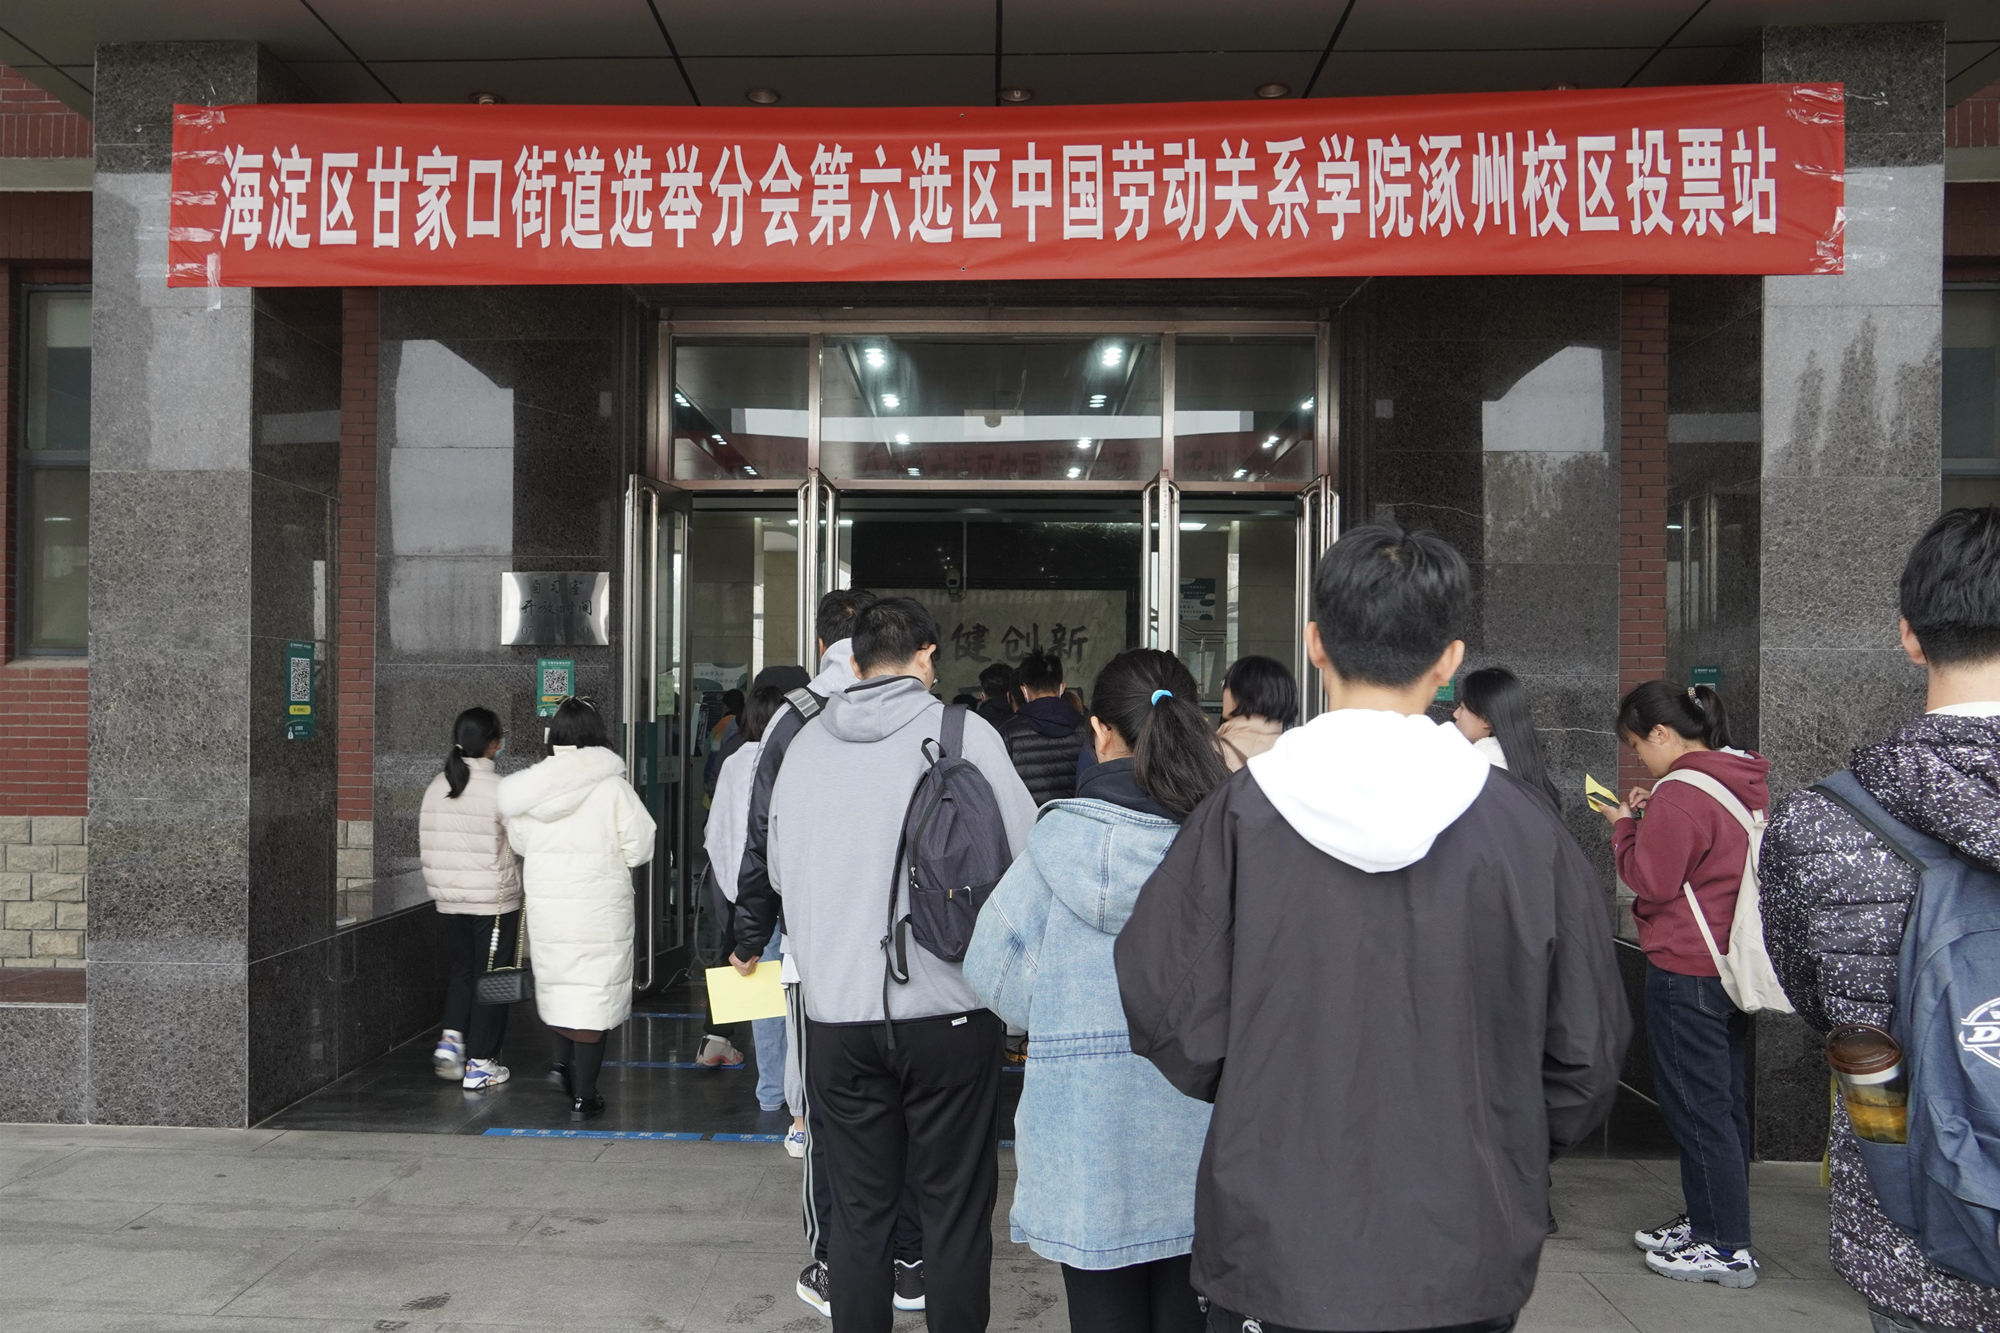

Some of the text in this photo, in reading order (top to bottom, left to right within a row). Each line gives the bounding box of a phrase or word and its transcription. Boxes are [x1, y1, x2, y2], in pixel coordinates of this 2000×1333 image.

[220, 126, 1777, 251] 海淀区甘家口街道选举分会第六选区中国劳动关系学院涿州校区投票站
[532, 579, 583, 596] 自习室
[520, 599, 592, 616] 开放时间
[937, 622, 1089, 664] 健创新
